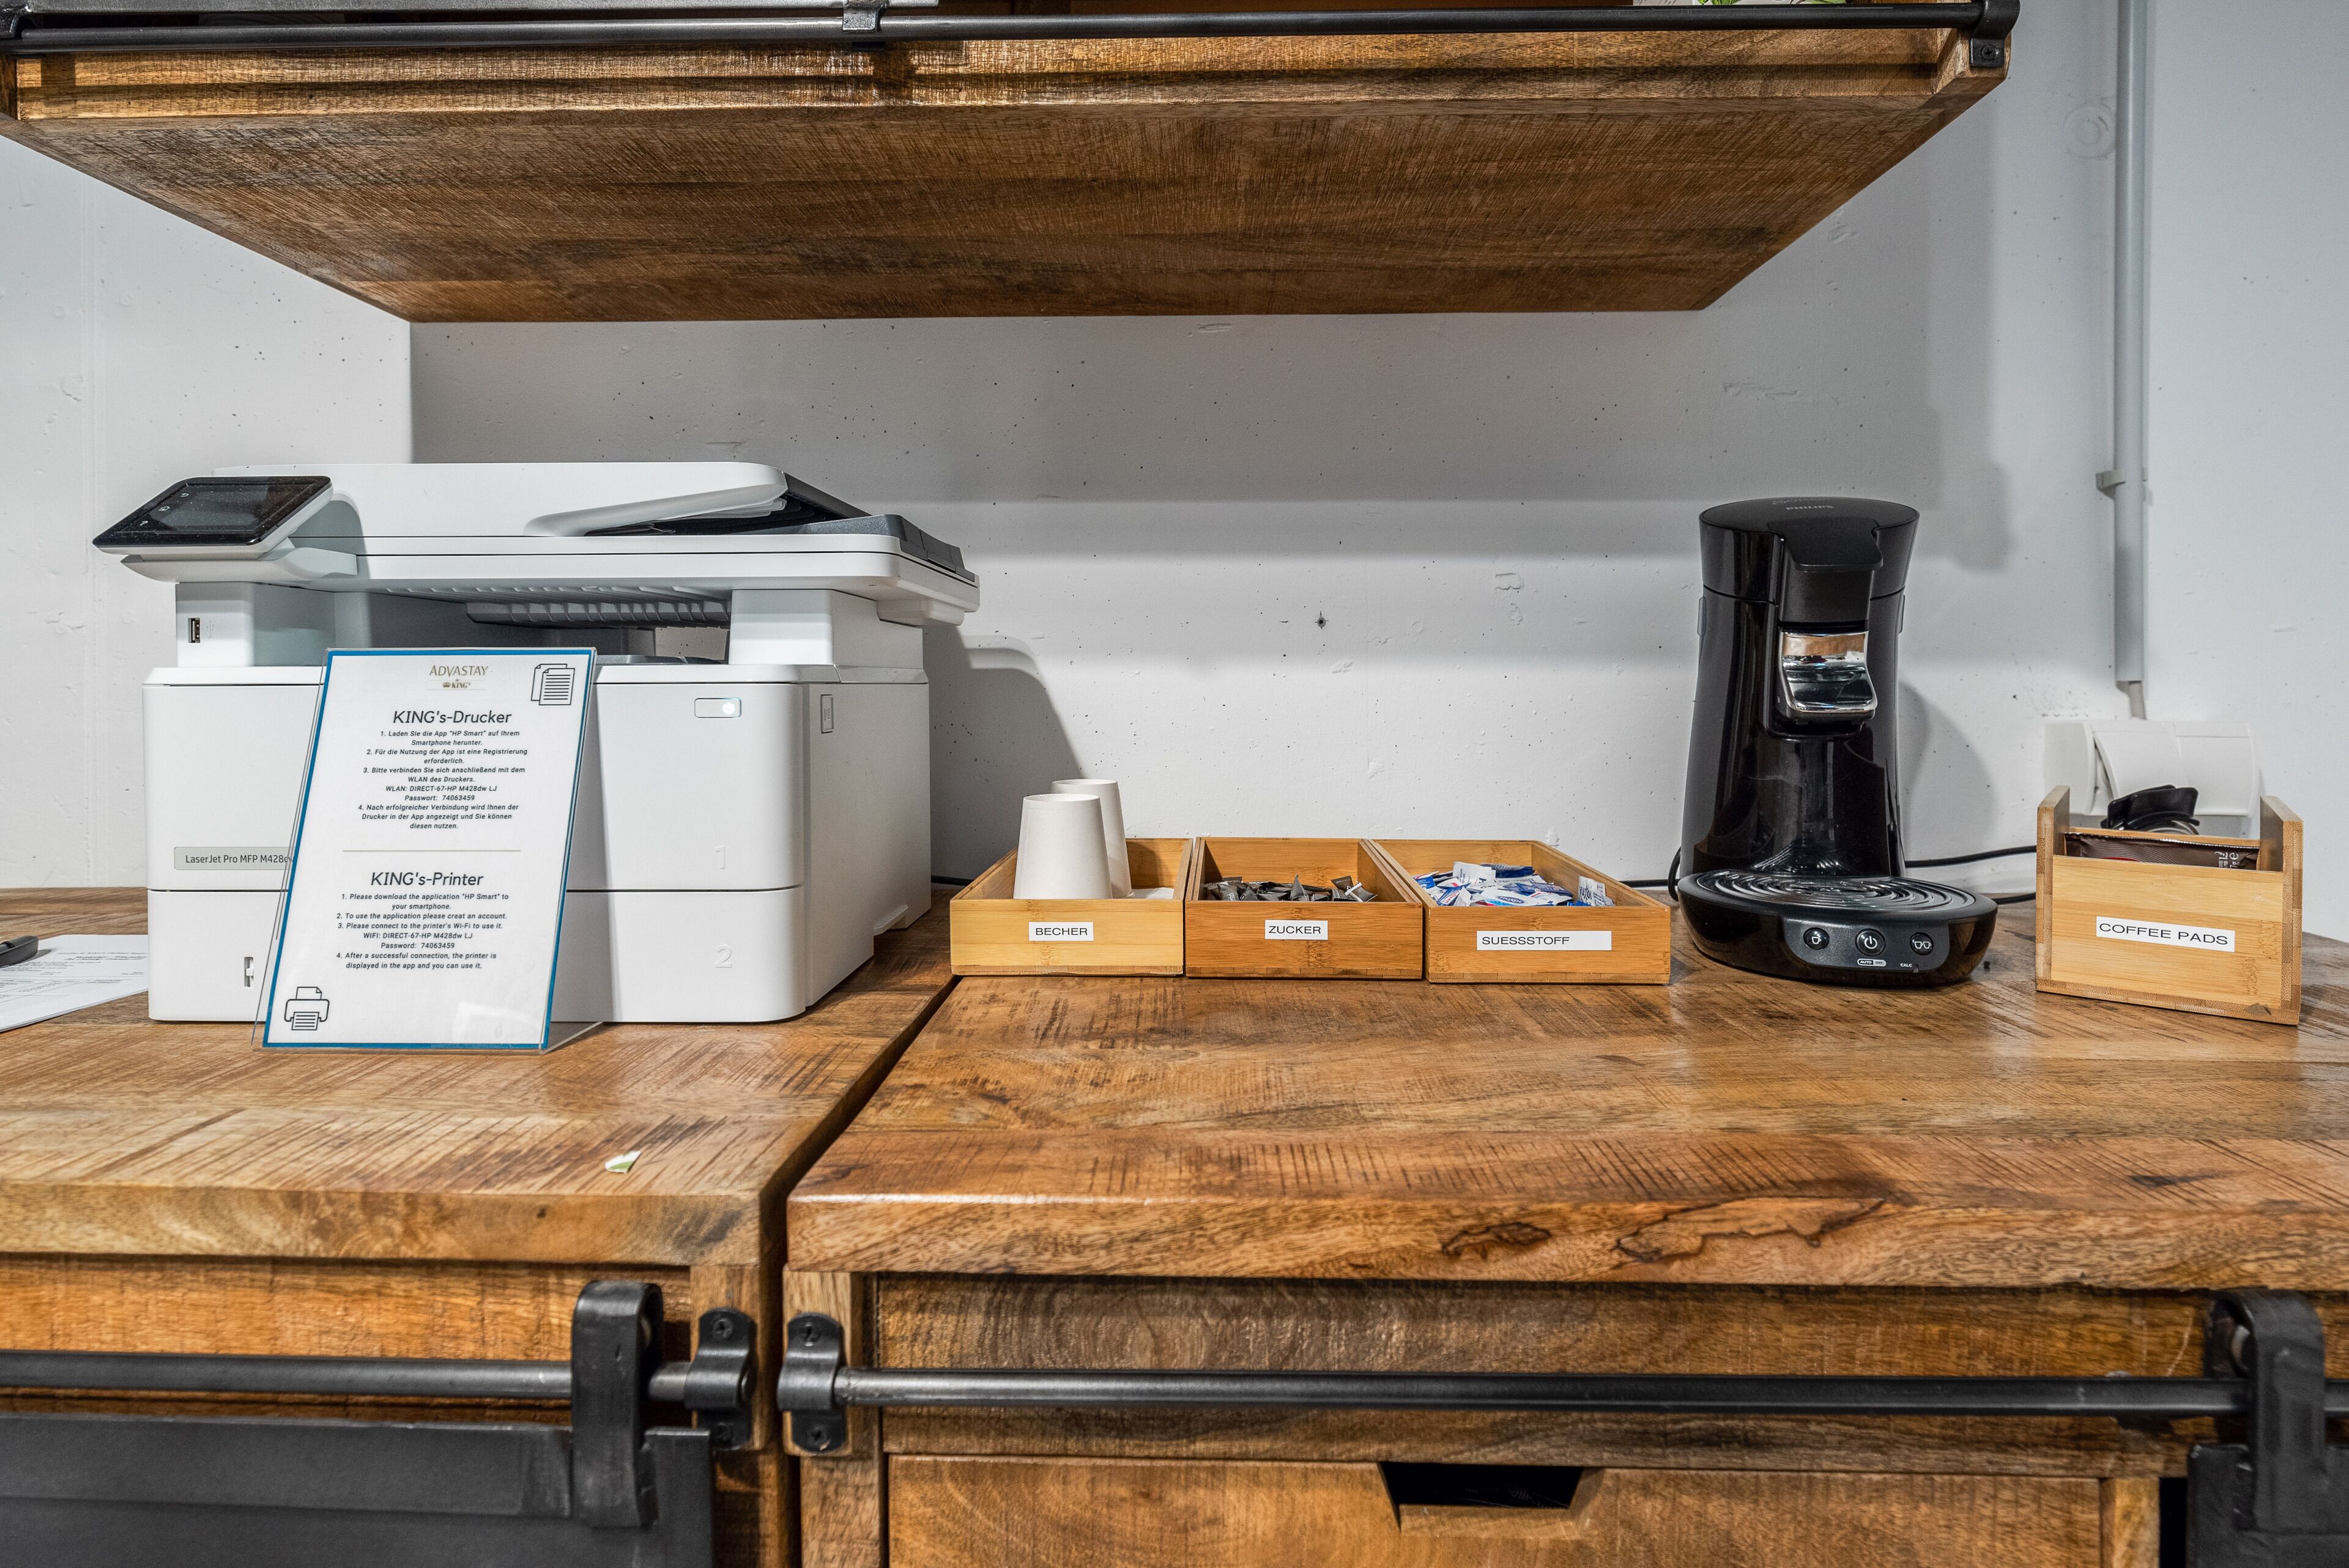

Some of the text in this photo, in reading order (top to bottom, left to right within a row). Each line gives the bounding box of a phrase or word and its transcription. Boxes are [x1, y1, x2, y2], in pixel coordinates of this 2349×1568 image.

[429, 664, 489, 677] ADVASTAY
[393, 710, 512, 723] KING's-Drucker
[185, 855, 221, 863] LaserJet
[223, 855, 238, 863] Pro
[240, 855, 258, 863] MFP
[714, 845, 727, 869] 1
[371, 872, 484, 886] KING's-Printer
[1268, 924, 1322, 935] ZUCKER
[2099, 923, 2228, 945] COFFEE PADS
[1482, 936, 1570, 946] SUESSSTOFF
[714, 943, 733, 968] 2
